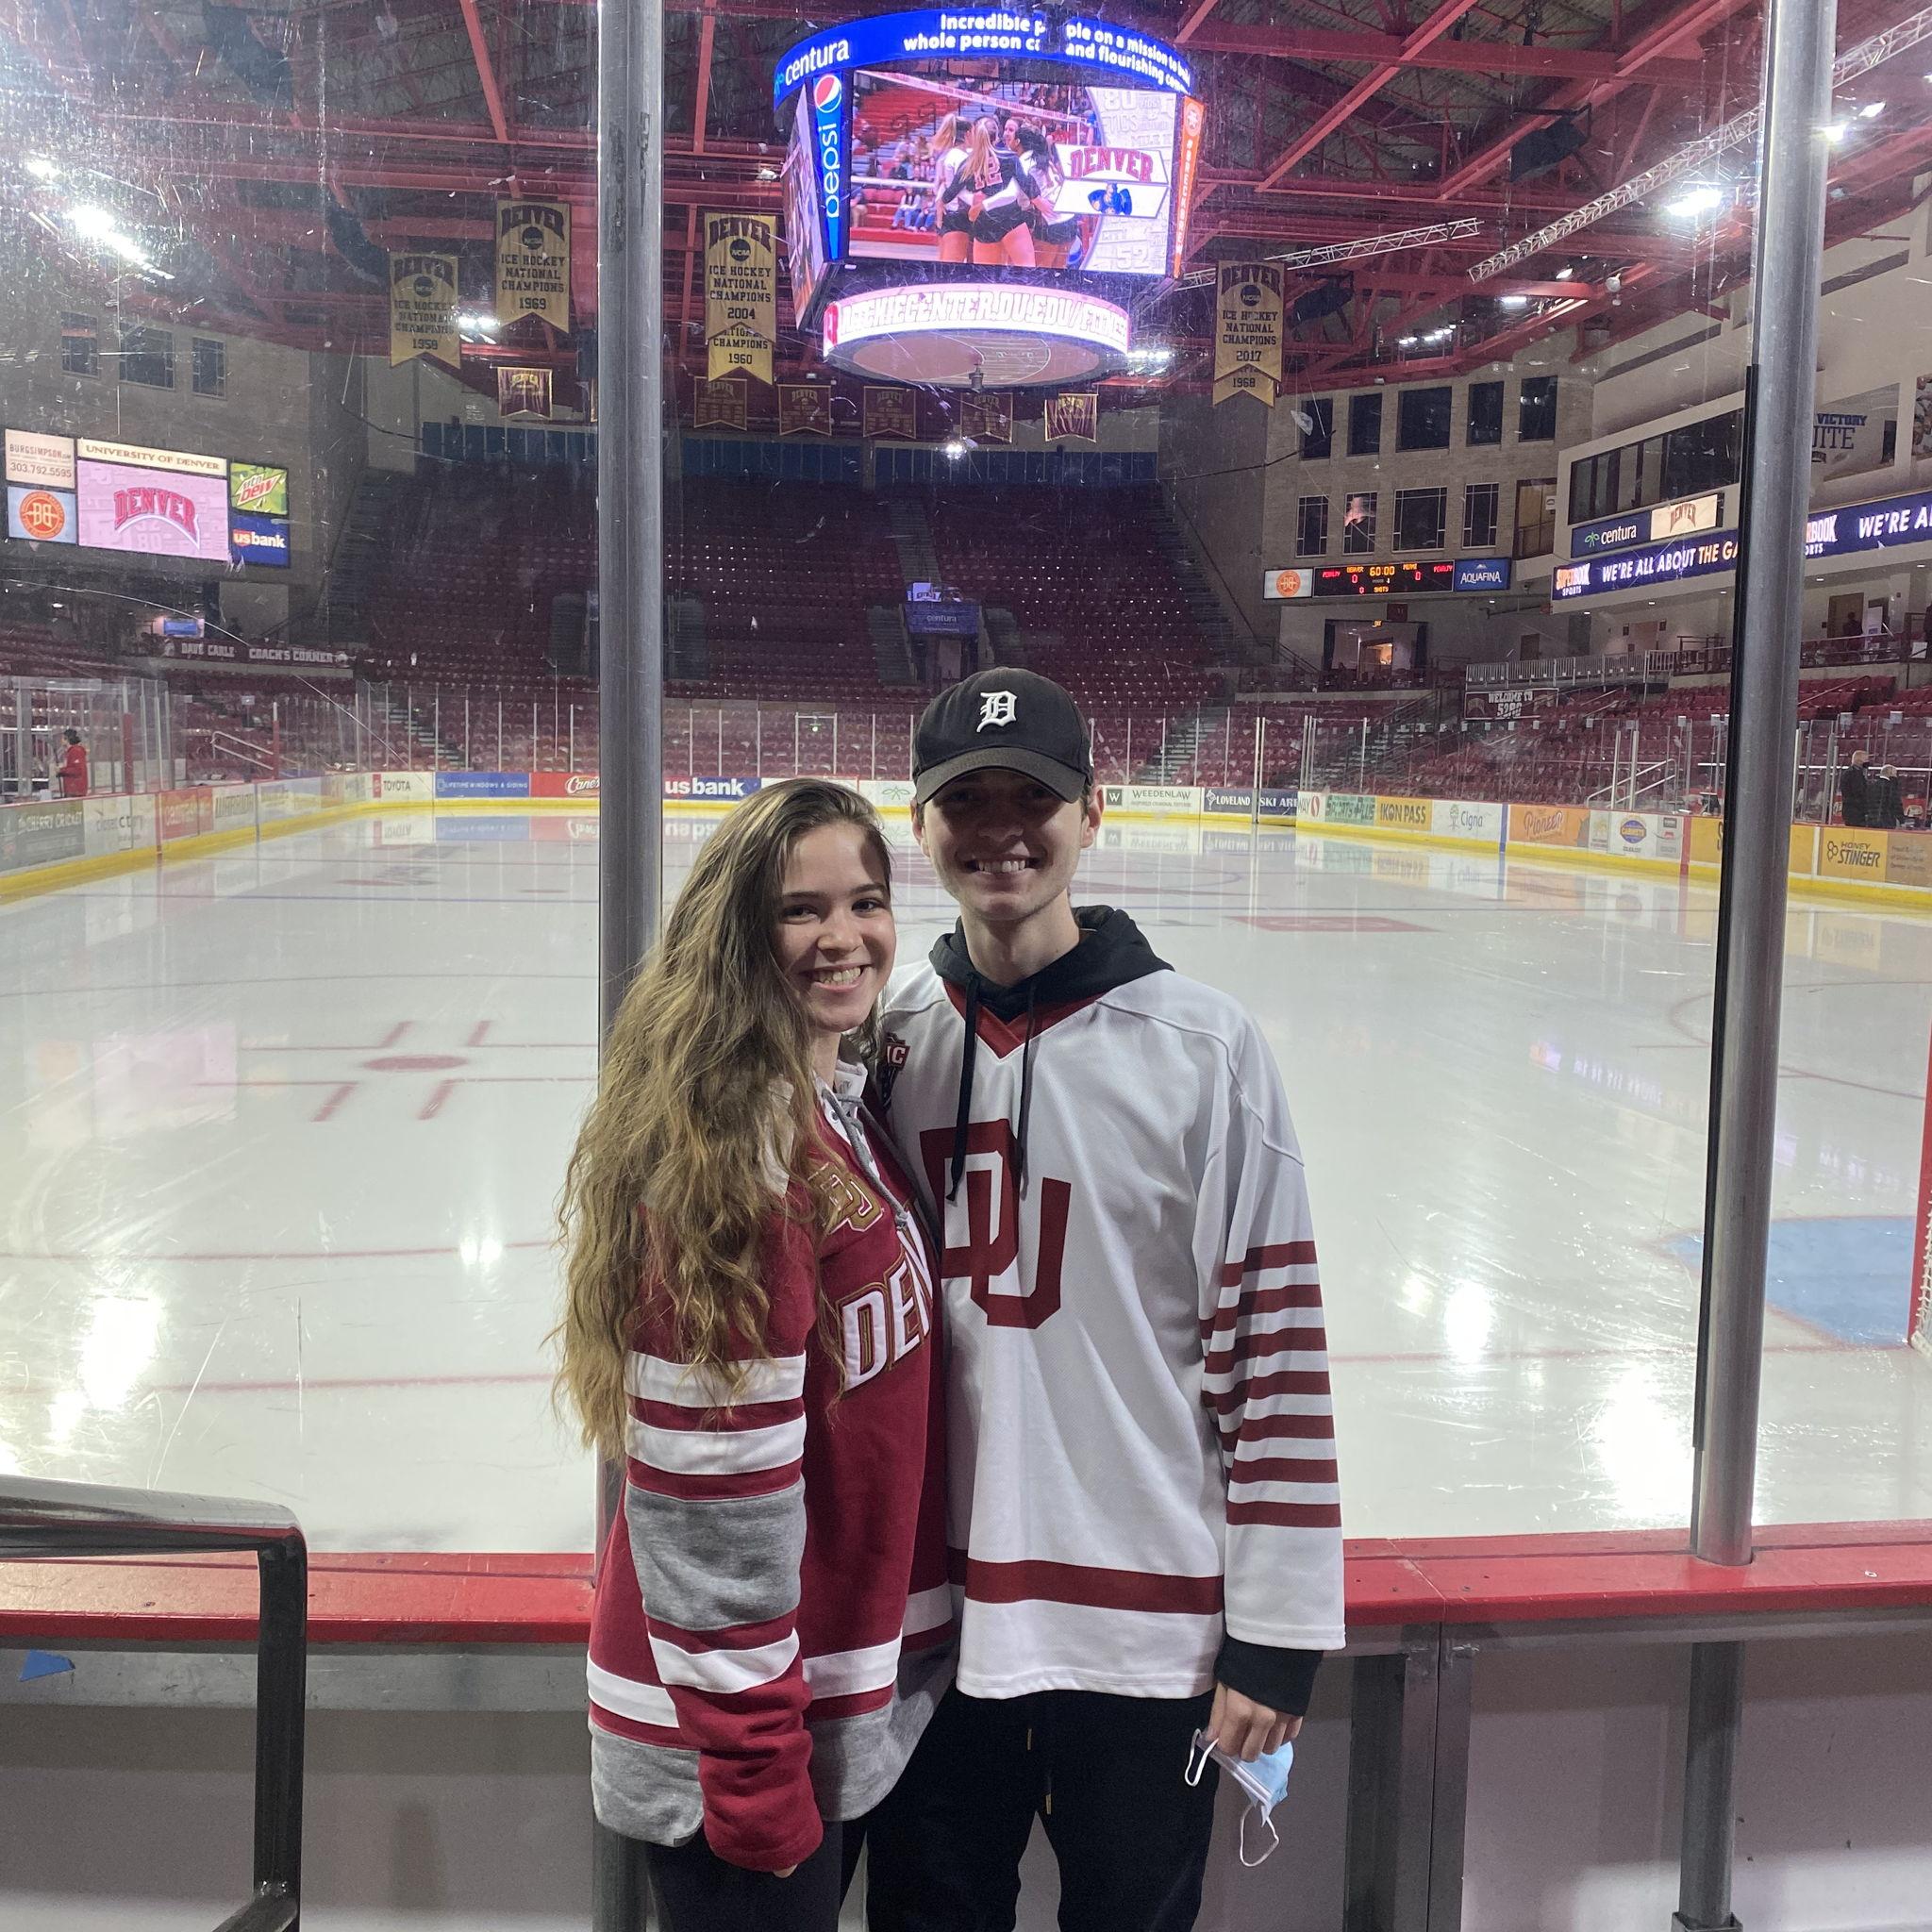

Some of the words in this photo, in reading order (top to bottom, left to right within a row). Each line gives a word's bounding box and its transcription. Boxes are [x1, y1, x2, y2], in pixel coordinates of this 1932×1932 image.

[941, 13, 1031, 32] Incredible
[1094, 29, 1114, 46] on
[1116, 35, 1124, 48] a
[1127, 38, 1168, 67] mission
[785, 39, 850, 86] centura
[903, 32, 957, 52] whole
[959, 34, 1022, 52] person
[1065, 42, 1095, 59] and
[1098, 45, 1164, 86] flourishing
[818, 123, 840, 218] pepsi
[1070, 147, 1154, 183] DENVER
[708, 217, 772, 254] DENVER
[501, 254, 519, 265] ICE
[523, 256, 565, 267] HOCKEY
[506, 267, 561, 280] NATIONAL
[708, 265, 726, 276] ICE
[730, 266, 772, 278] HOCKEY
[501, 280, 565, 293] CHAMPIONS
[713, 279, 767, 291] NATIONAL
[519, 297, 547, 310] 1969
[709, 291, 772, 304] CHAMPIONS
[727, 308, 756, 320] 2004
[1223, 309, 1238, 321] ICE
[1225, 323, 1274, 334] NATIONAL
[713, 338, 768, 350] CHAMPIONS
[1223, 335, 1276, 345] CHAMPIONS
[728, 353, 753, 365] 1960
[1236, 350, 1262, 363] 2017
[1232, 377, 1257, 389] 1968
[1817, 412, 1868, 426] VICTORY
[1811, 425, 1857, 450] UITE
[86, 444, 156, 462] UNIVERSITY
[158, 455, 174, 465] OF
[176, 458, 221, 470] DENVER
[114, 486, 199, 544] DENVER
[1858, 508, 1911, 539] WE'RE
[1601, 525, 1637, 545] centura
[1602, 561, 1633, 583] WE'RE
[1637, 558, 1656, 577] ALL
[1657, 547, 1697, 573] ABOUT
[1698, 543, 1719, 565] THE
[1351, 574, 1358, 584] 0
[1415, 571, 1423, 581] 0
[1369, 565, 1396, 577] 60:00
[1460, 572, 1502, 585] AQUAFINA
[1562, 584, 1582, 596] SPORTS
[926, 614, 957, 623] centura
[248, 648, 290, 660] COACH'S
[976, 690, 1018, 733] D
[383, 780, 410, 792] TOYOTA
[1216, 796, 1251, 806] LOVELAND
[1259, 797, 1276, 807] SKI
[1380, 803, 1403, 823] IKON
[1404, 805, 1426, 824] PASS
[1461, 810, 1483, 831] Cigna
[1840, 841, 1872, 850] HONEY
[1837, 849, 1881, 868] STINGER
[919, 1118, 1073, 1330] DU
